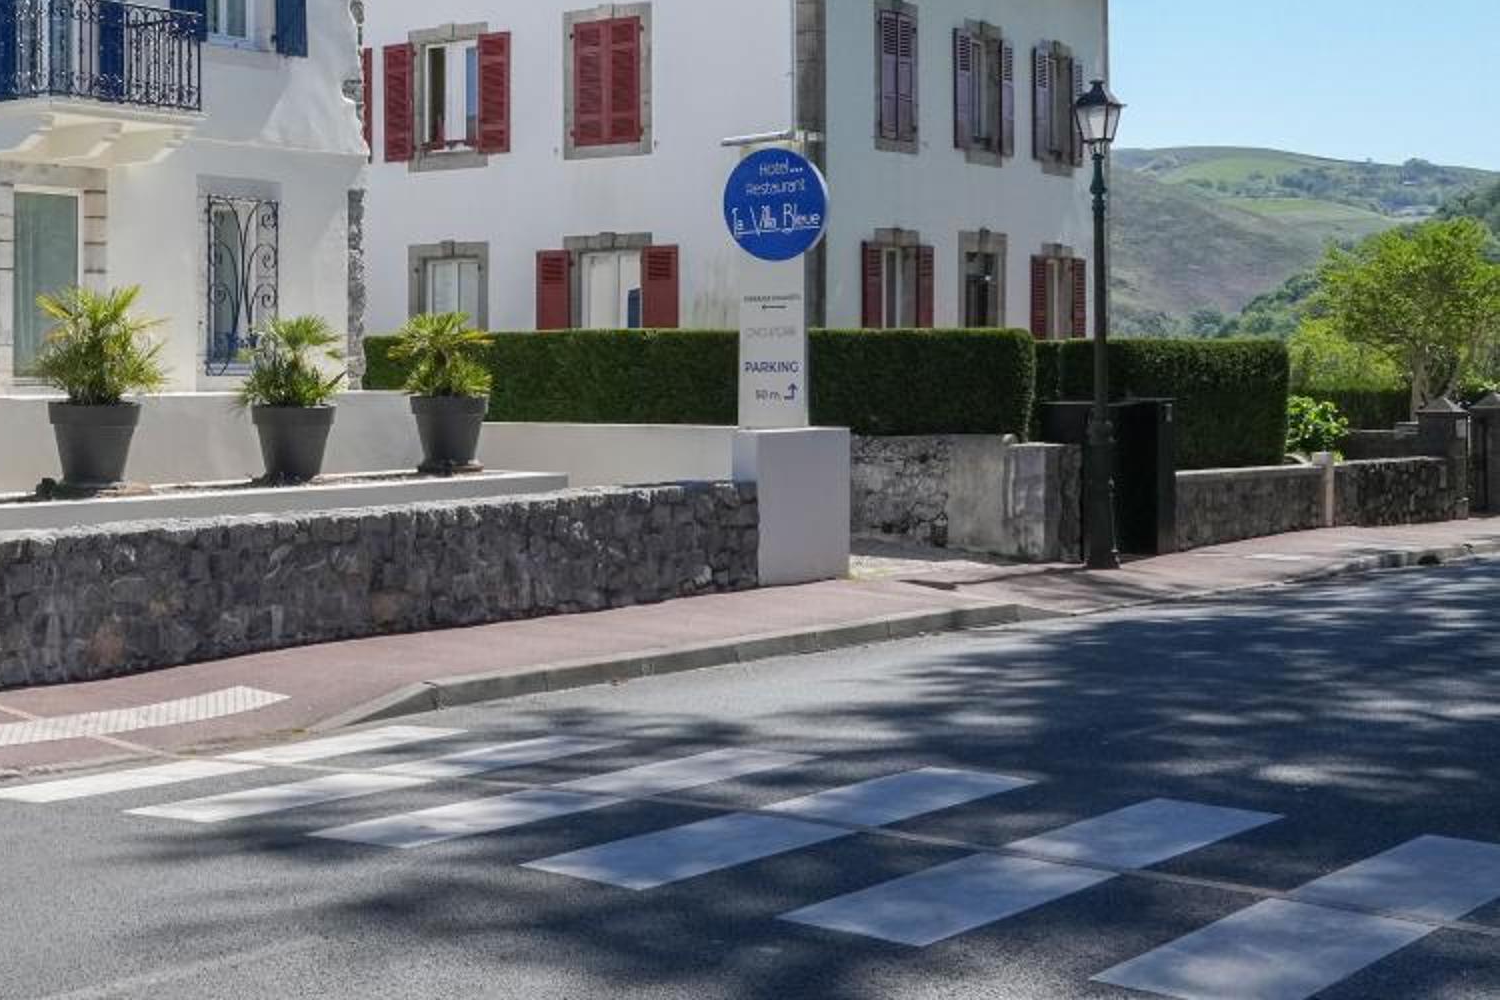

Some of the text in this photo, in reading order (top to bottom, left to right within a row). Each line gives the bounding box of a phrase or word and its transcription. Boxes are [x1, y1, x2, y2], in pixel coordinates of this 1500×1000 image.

[745, 178, 805, 196] Restaurant
[783, 203, 821, 234] Bleue
[744, 361, 799, 373] PARKING
